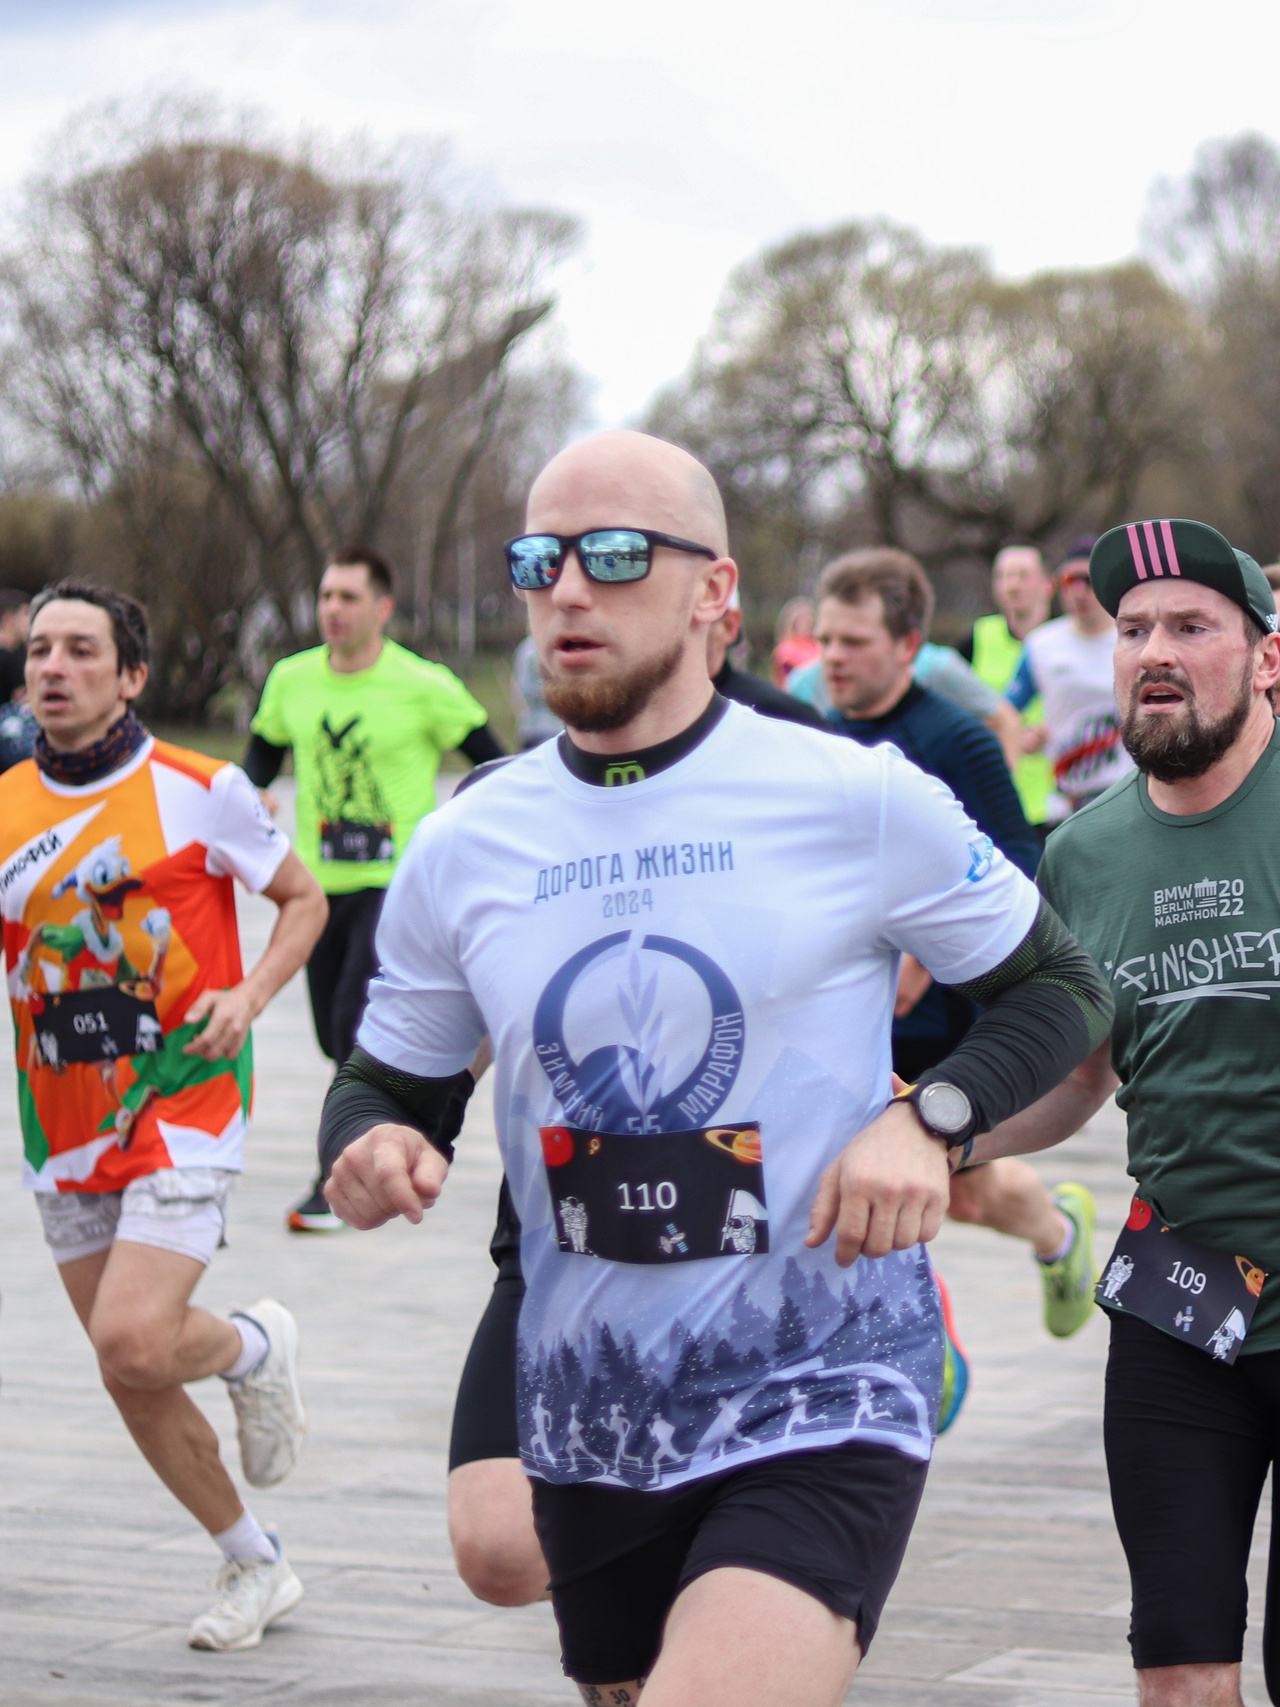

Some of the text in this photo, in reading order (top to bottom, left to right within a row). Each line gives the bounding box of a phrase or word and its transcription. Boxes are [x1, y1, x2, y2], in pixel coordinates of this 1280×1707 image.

[534, 841, 734, 904] ДОРОГА ЖИЗНИ
[1154, 883, 1194, 905] BMW
[1218, 878, 1245, 898] 20
[602, 888, 654, 919] 2024
[1154, 898, 1194, 917] BERLIN
[1218, 898, 1245, 917] 22
[1154, 906, 1218, 928] MARATHON
[73, 1010, 109, 1035] 051
[536, 1011, 743, 1134] ЗИМНИЙ 55 МАРАФОН
[617, 1181, 678, 1210] 110
[1166, 1261, 1207, 1295] 109
